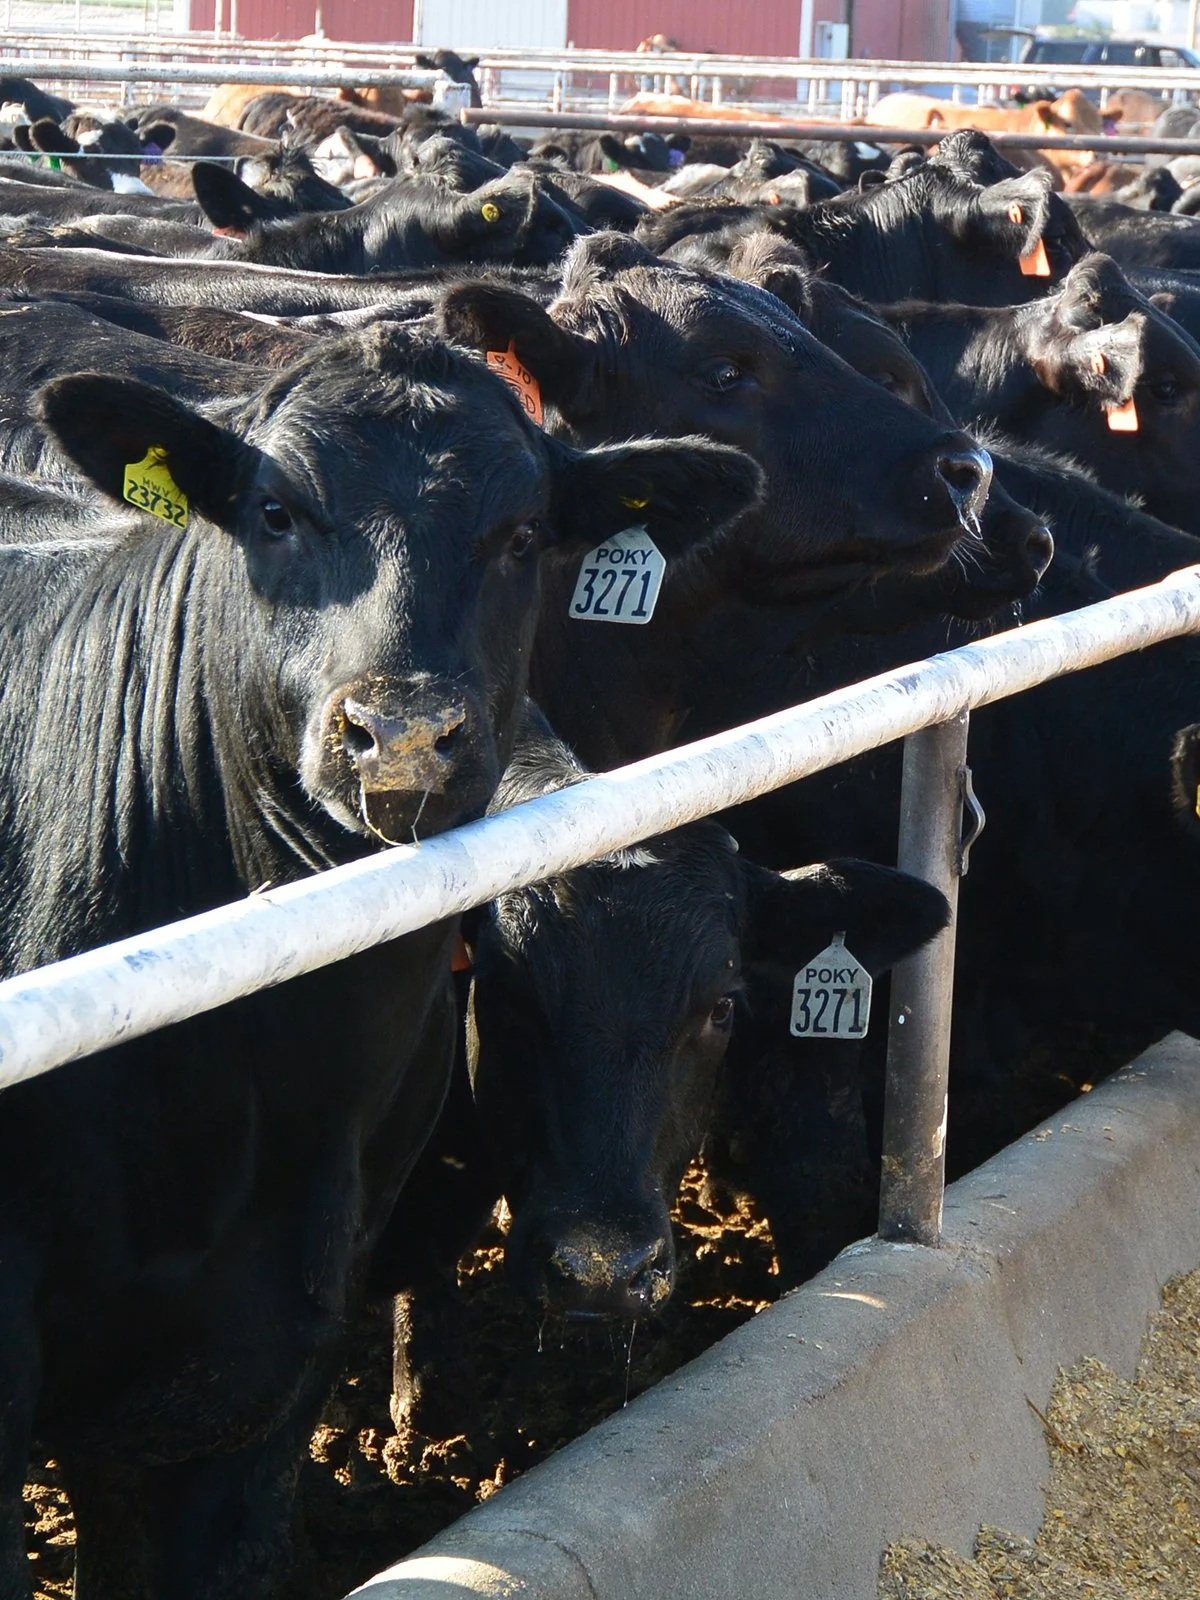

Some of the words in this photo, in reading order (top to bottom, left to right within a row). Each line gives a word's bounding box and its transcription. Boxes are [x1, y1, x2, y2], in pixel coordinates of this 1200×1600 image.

[127, 479, 186, 528] 23732
[595, 548, 654, 565] POKY
[575, 568, 652, 617] 3271
[805, 968, 859, 984] POKY
[795, 988, 863, 1033] 3271
